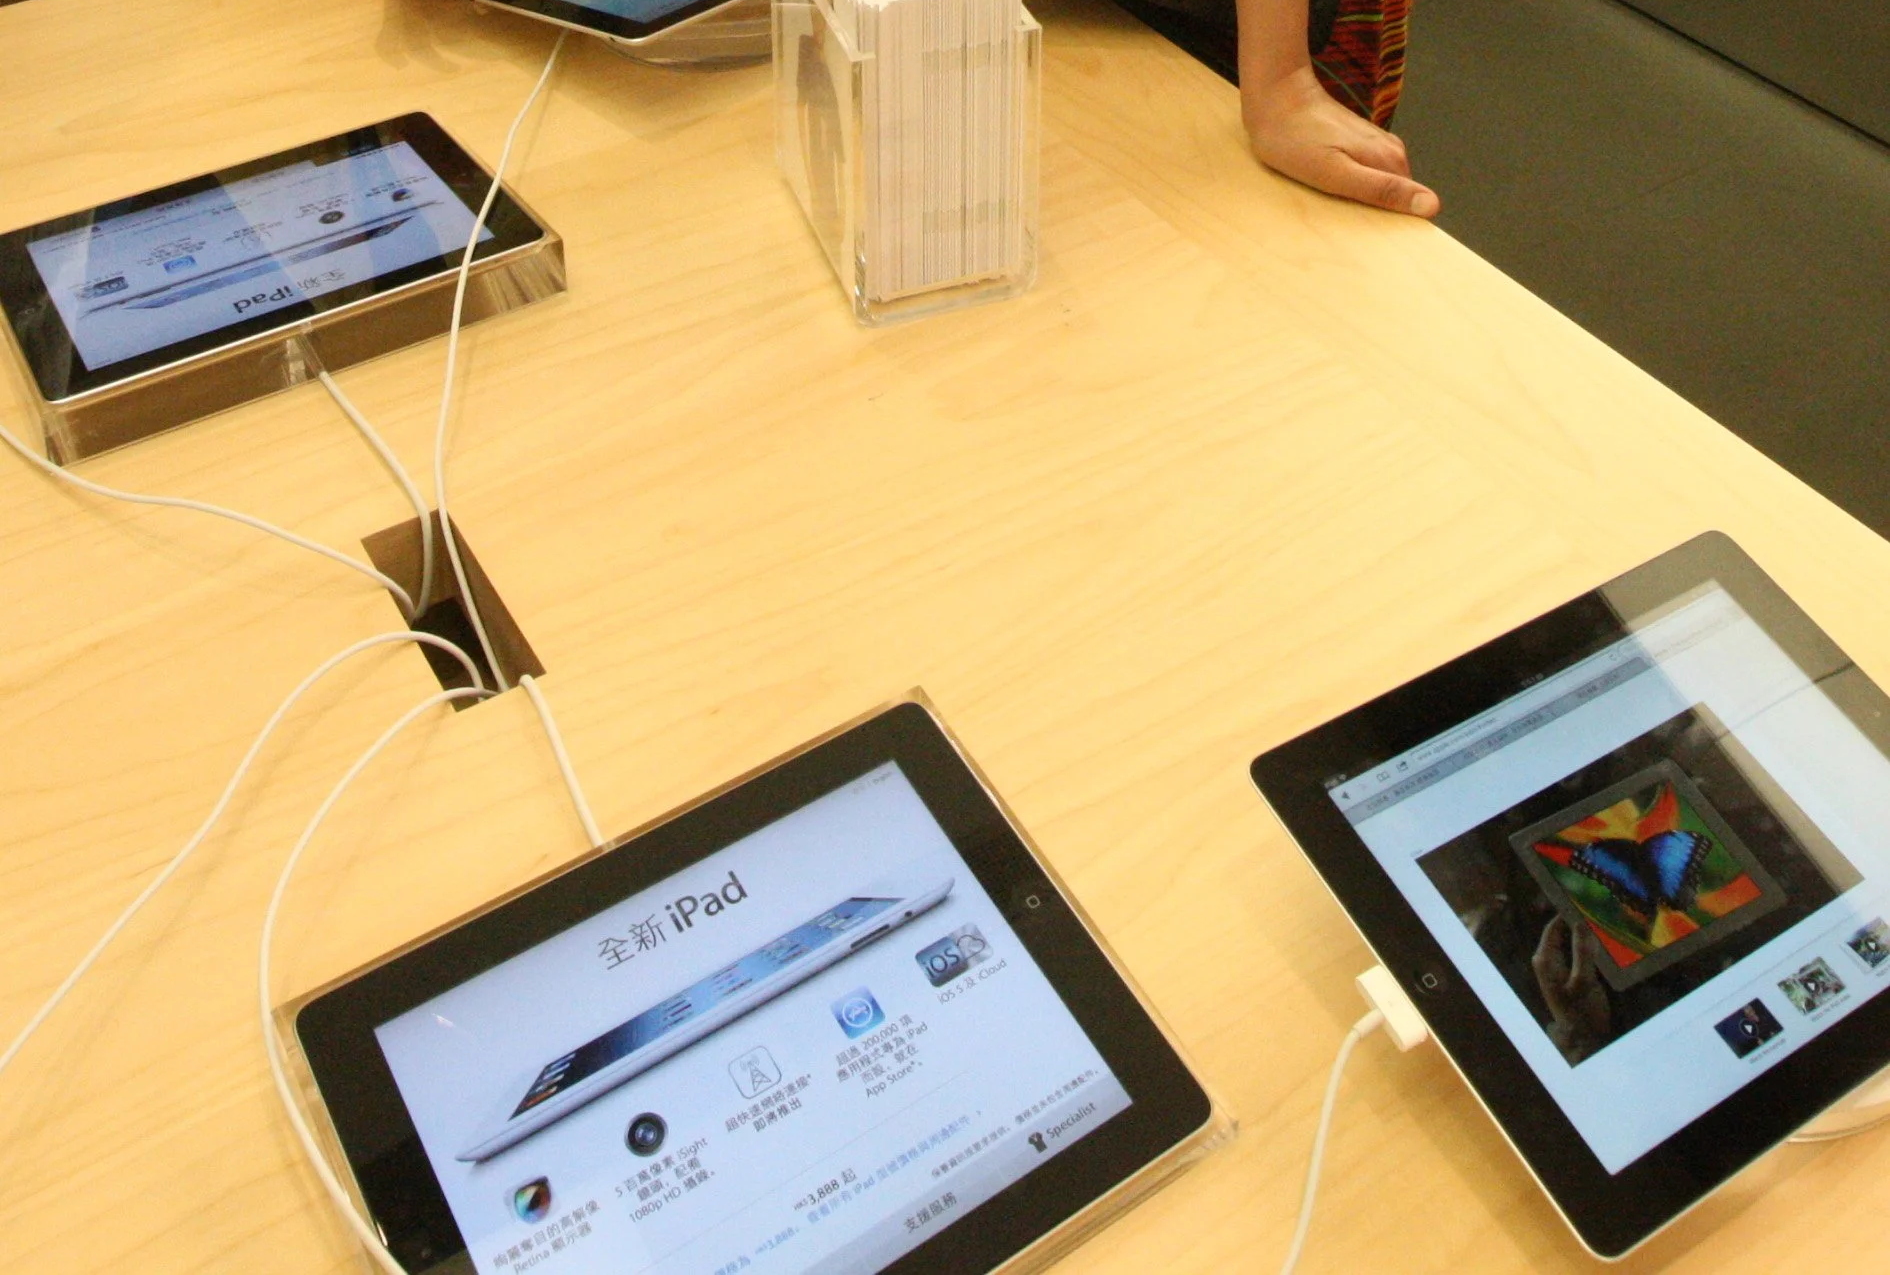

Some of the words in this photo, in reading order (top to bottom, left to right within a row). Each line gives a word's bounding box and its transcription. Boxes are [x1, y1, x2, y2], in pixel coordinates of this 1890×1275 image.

[233, 285, 294, 314] iPad
[598, 913, 667, 971] 全新
[664, 869, 748, 933] iPad
[923, 947, 960, 979] iOS
[937, 989, 956, 1005] iOS
[956, 984, 964, 994] 5
[978, 958, 1008, 981] iCloud
[862, 1022, 899, 1051] 200,000
[905, 1021, 928, 1040] iPad
[865, 1081, 887, 1099] App
[1046, 1100, 1098, 1140] Specialist
[615, 1186, 623, 1198] 5
[676, 1137, 708, 1161] iSight
[629, 1198, 663, 1223] 1080p
[663, 1186, 682, 1204] HD
[903, 1190, 958, 1235] 支援服務
[513, 1249, 551, 1275] Retina
